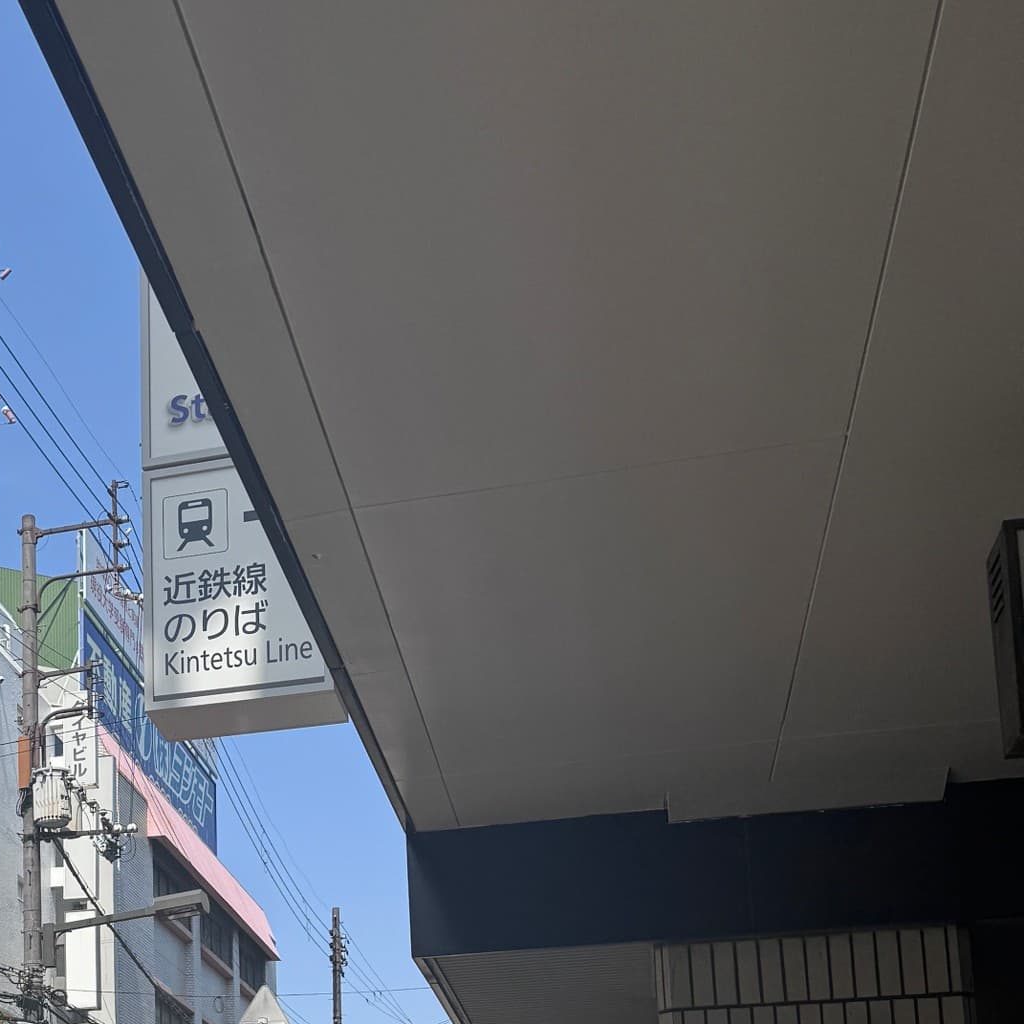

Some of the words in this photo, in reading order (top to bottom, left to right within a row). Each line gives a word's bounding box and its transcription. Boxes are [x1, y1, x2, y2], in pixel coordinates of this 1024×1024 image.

[167, 394, 211, 427] St
[163, 562, 267, 607] 近鉄線
[163, 601, 269, 643] のりば
[164, 645, 257, 676] Kintetsu
[266, 637, 314, 665] Line
